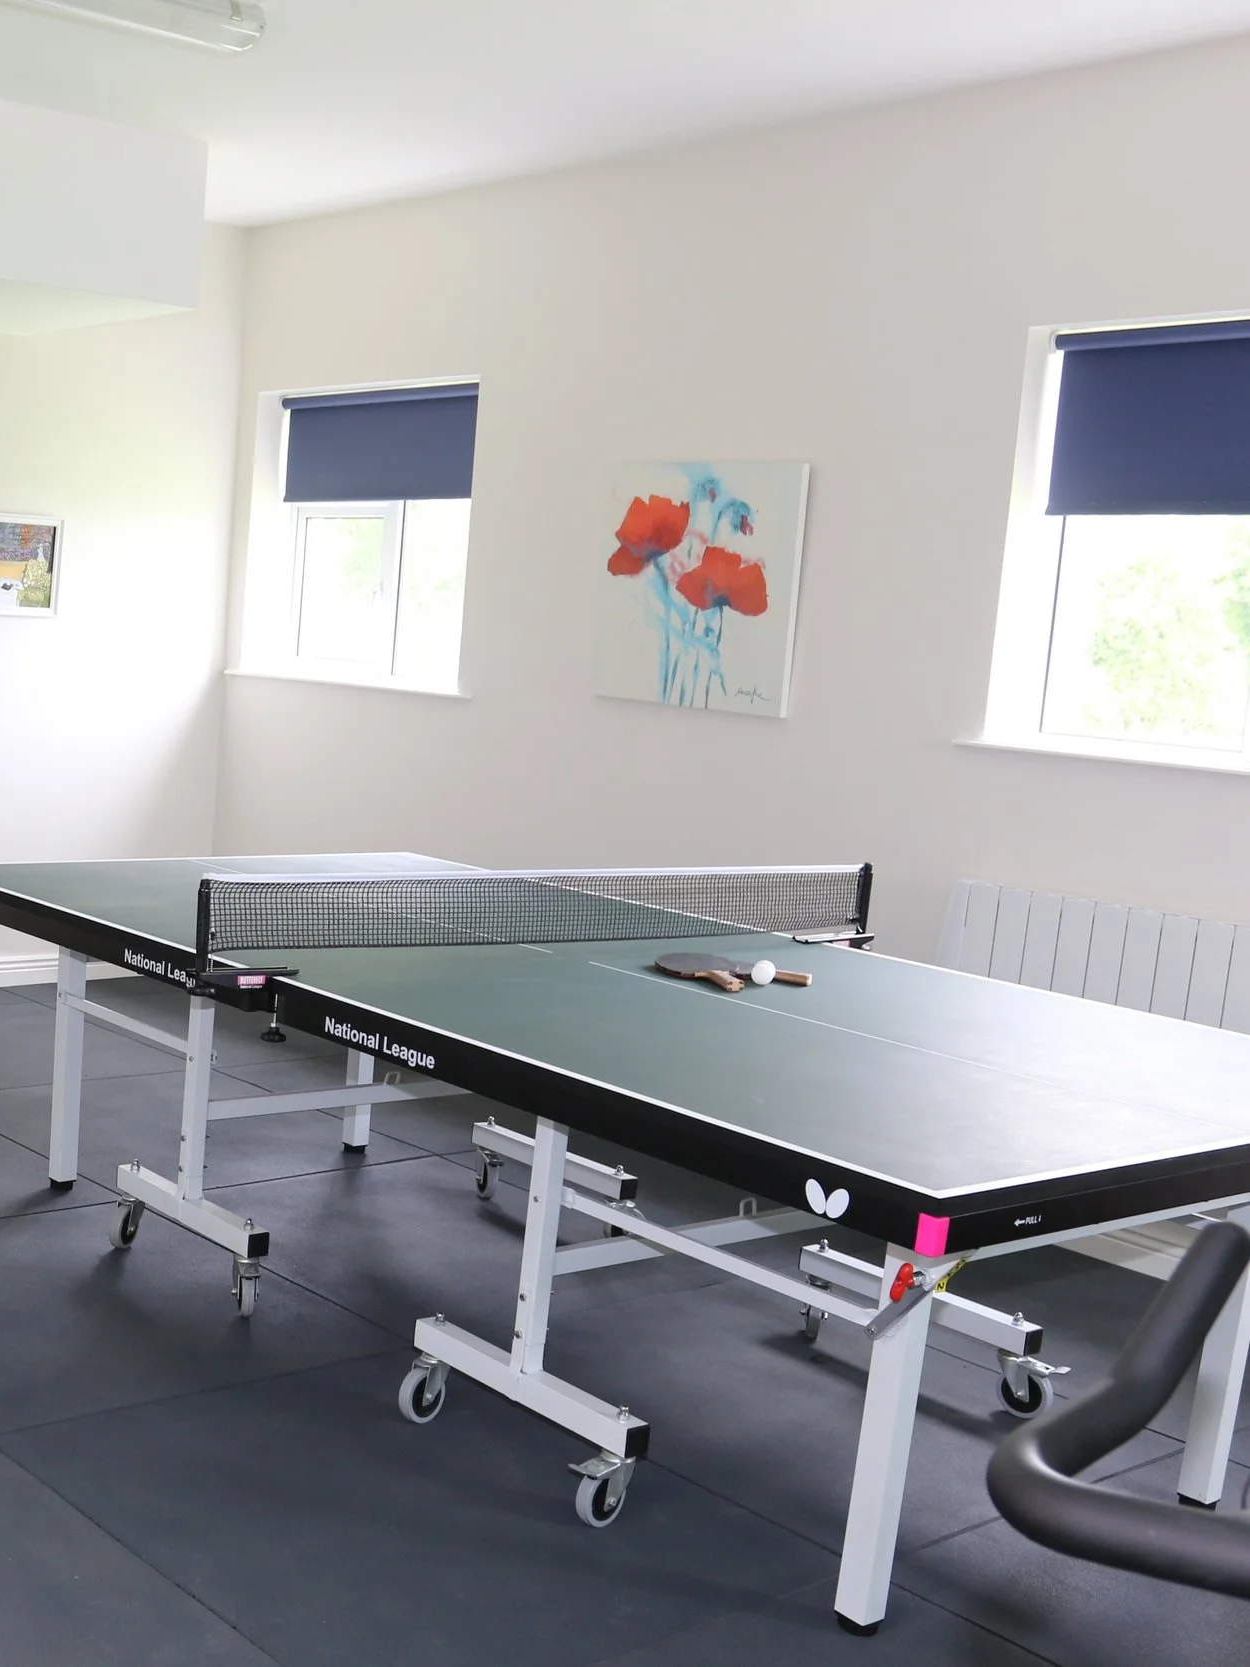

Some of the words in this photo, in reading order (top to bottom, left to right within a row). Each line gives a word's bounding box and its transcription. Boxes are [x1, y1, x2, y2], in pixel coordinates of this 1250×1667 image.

[124, 948, 165, 976] National
[324, 1016, 380, 1050] National
[382, 1036, 436, 1069] League
